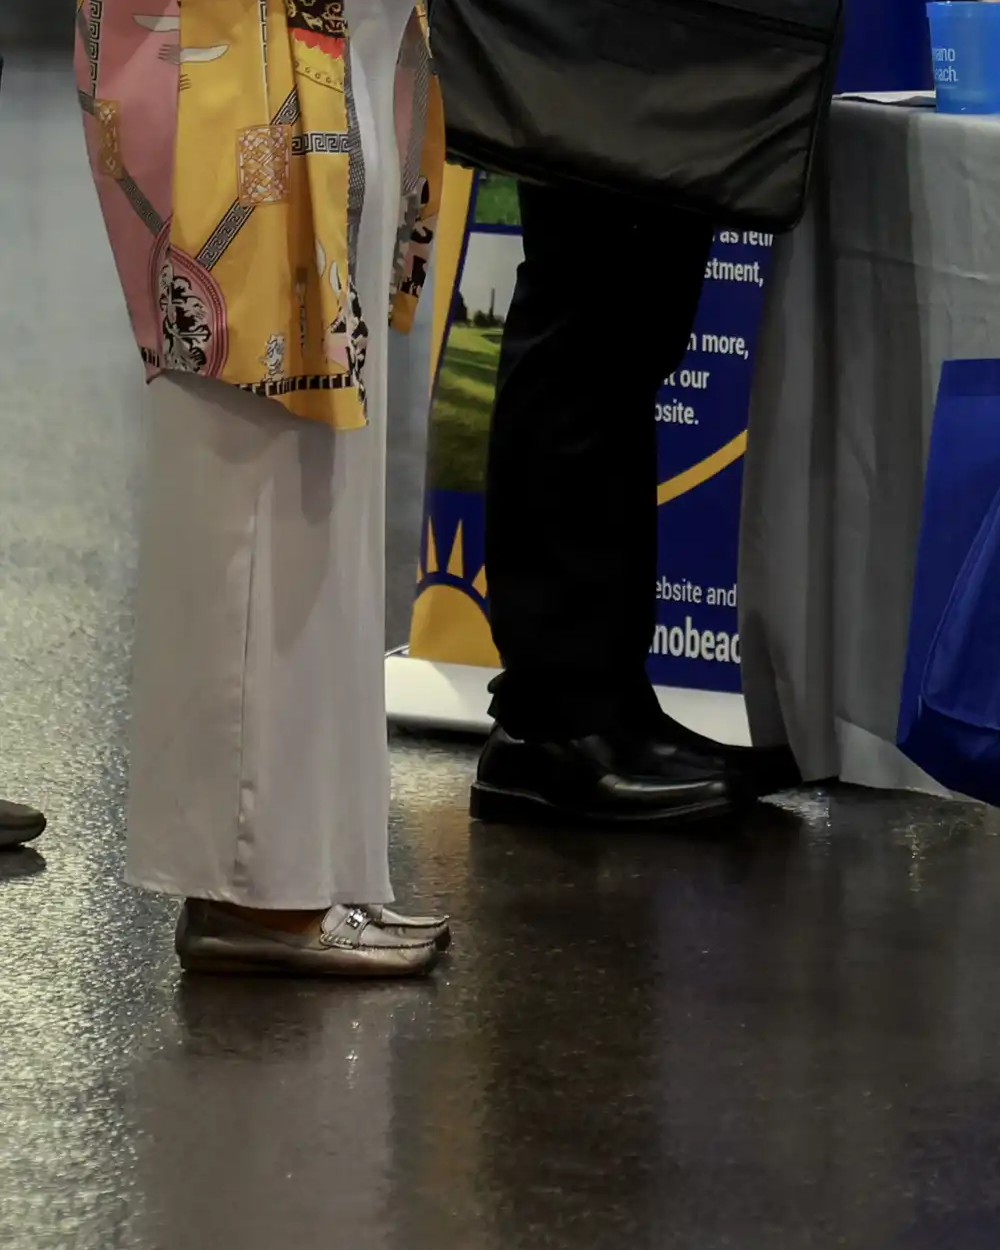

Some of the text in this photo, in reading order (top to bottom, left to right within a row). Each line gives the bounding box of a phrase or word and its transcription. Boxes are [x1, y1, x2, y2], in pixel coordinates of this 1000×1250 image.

[701, 333, 750, 361] more,
[679, 369, 711, 389] our
[706, 583, 738, 607] and
[648, 615, 742, 664] nobeac
